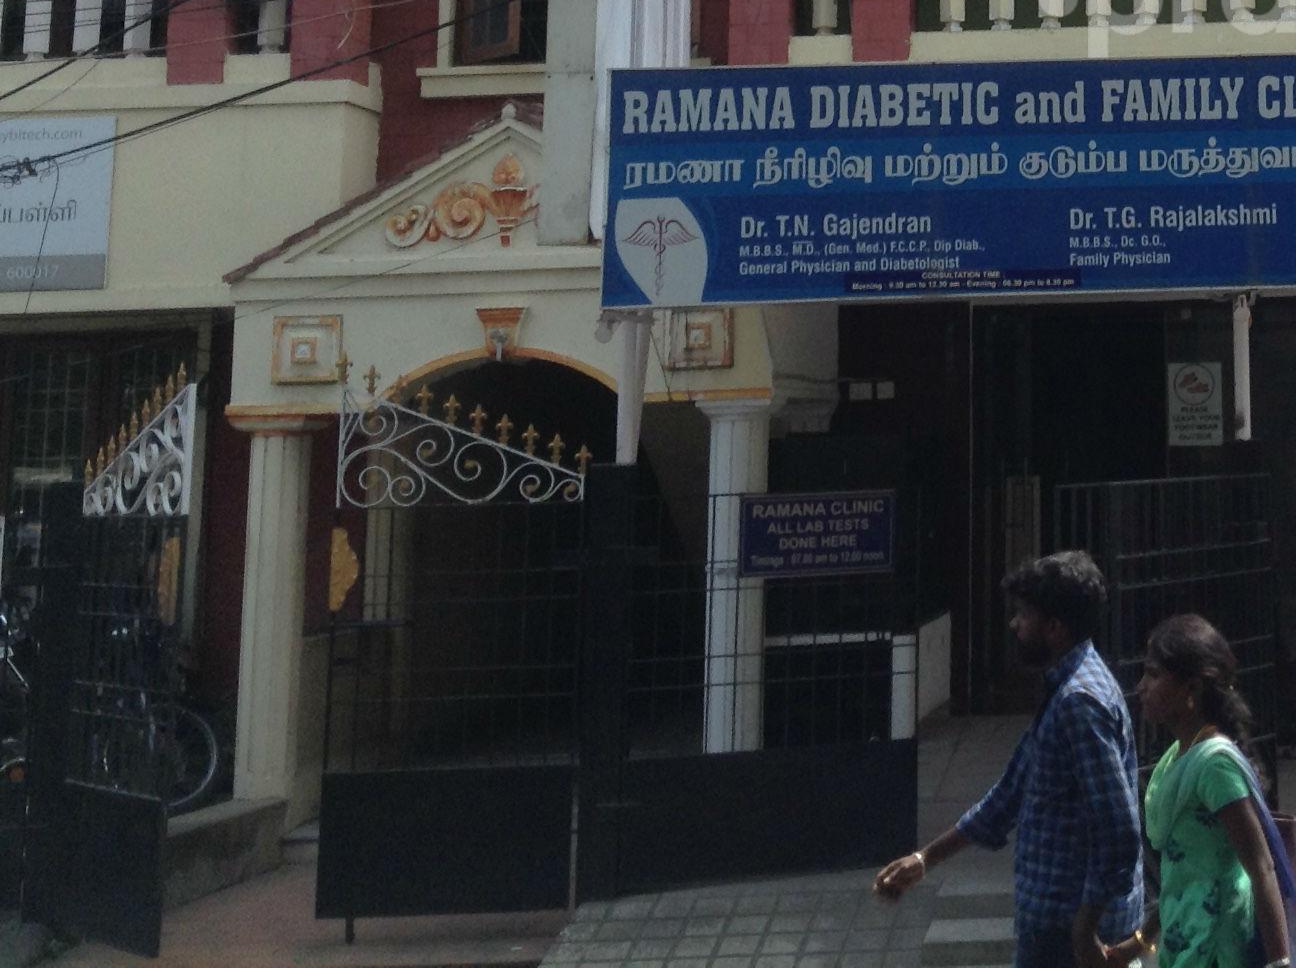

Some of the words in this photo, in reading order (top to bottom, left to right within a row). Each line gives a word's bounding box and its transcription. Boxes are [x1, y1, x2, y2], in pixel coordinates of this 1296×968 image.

[623, 86, 795, 134] RAMANA
[810, 81, 1000, 128] DIABETIC
[1014, 80, 1087, 124] and
[1100, 76, 1244, 122] FAMILY
[624, 158, 746, 190] ரமணா
[752, 147, 873, 189] நீரிழிவு
[884, 142, 1008, 186] மற்றும்
[1018, 139, 1128, 179] குடும்ப
[740, 216, 768, 238] Dr.
[776, 214, 815, 237] T.N.
[823, 212, 931, 239] Gajendran
[1069, 208, 1097, 230] Dr.
[1104, 206, 1142, 229] T.G.
[1150, 203, 1277, 231] Rajalakshmi
[739, 261, 787, 276] General
[790, 259, 850, 277] Physician
[854, 258, 877, 272] and
[880, 256, 960, 273] Diabetologist
[1069, 253, 1110, 267] Family
[1113, 251, 1171, 267] Physician
[752, 504, 826, 518] RAMANA
[830, 500, 884, 515] CLINIC
[767, 522, 792, 534] ALL
[797, 520, 824, 532] LAB
[828, 518, 869, 531] TESTS
[779, 537, 816, 549] DONE
[821, 534, 857, 547] HERE
